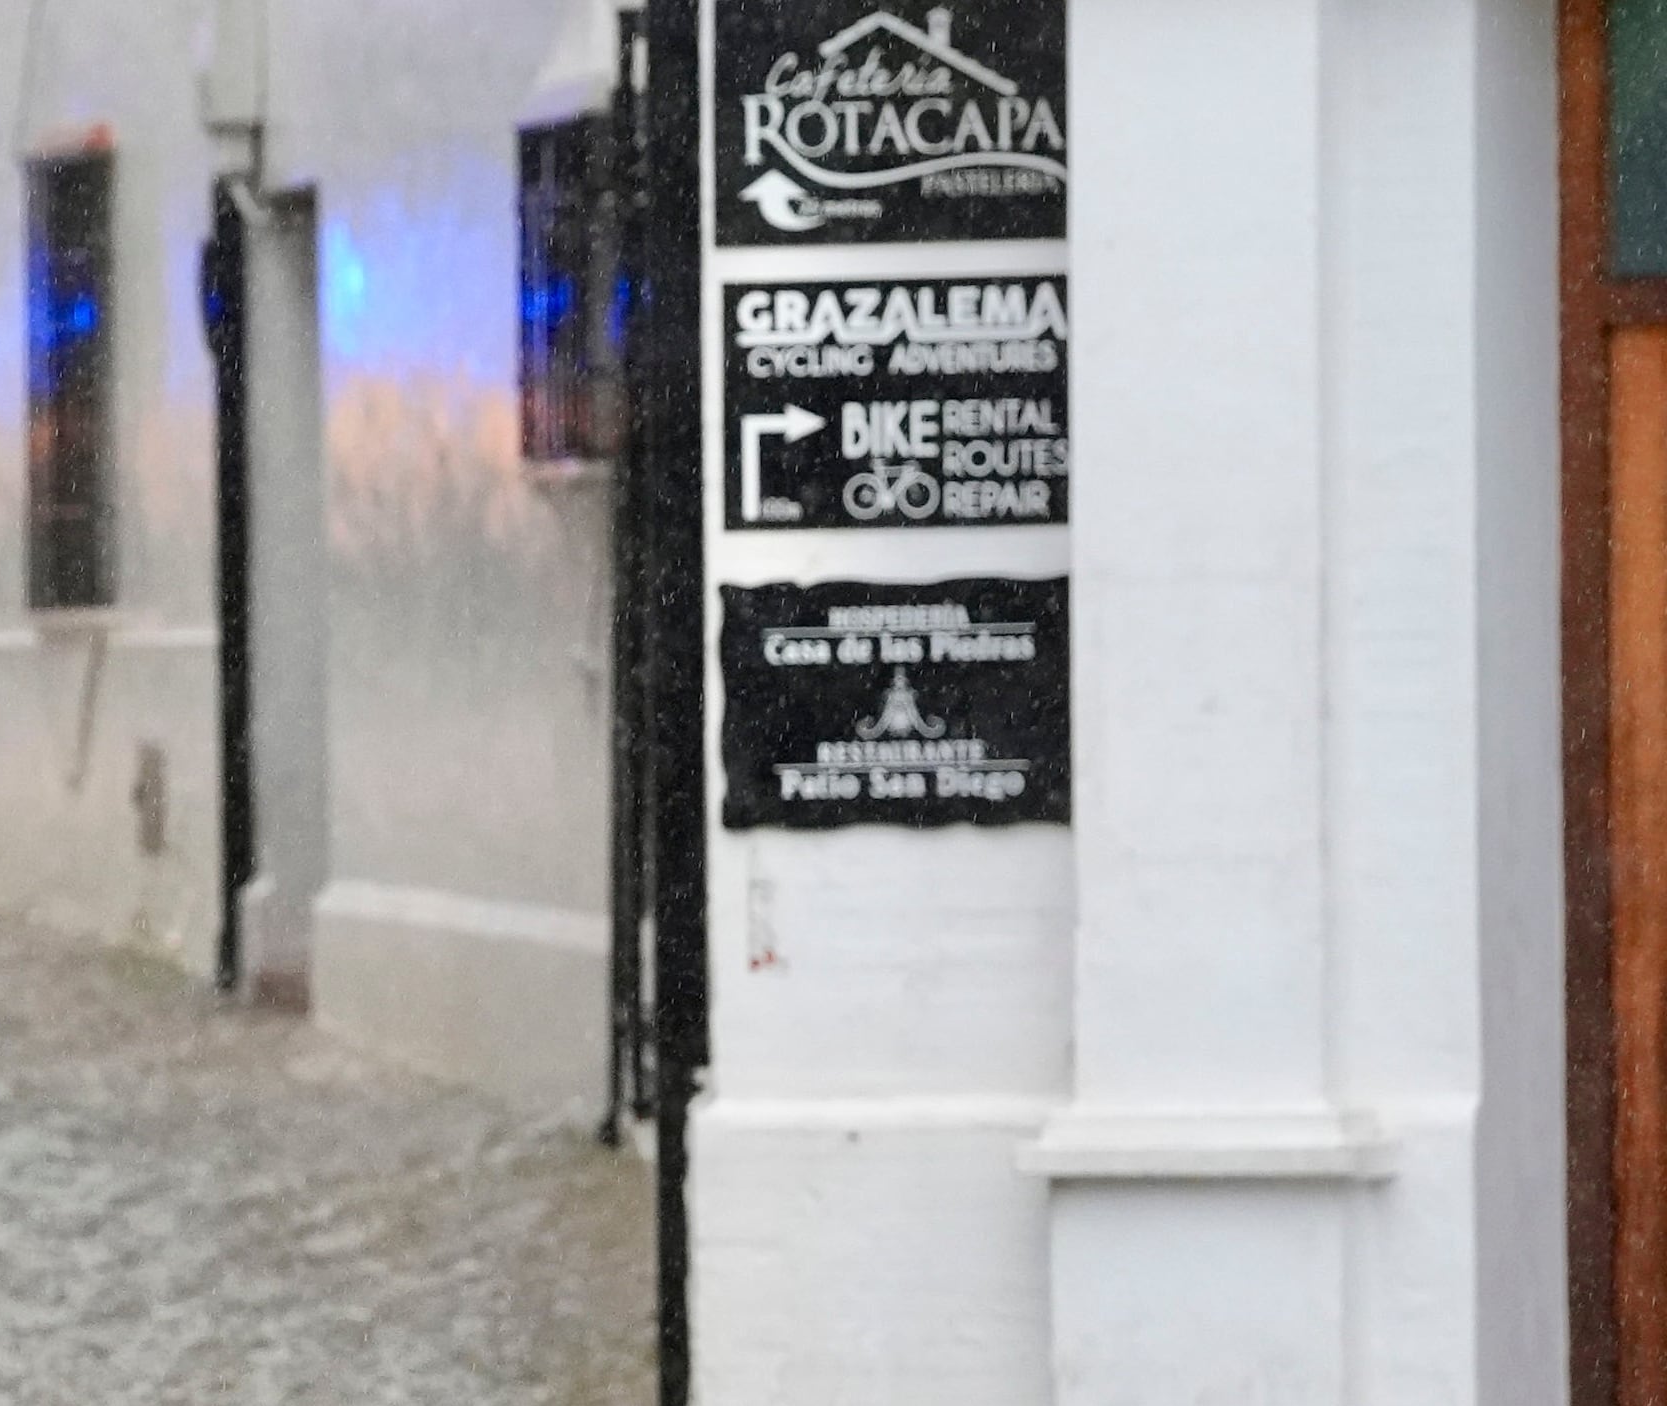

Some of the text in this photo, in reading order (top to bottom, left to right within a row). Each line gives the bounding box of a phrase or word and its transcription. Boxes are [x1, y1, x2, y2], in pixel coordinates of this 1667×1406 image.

[741, 94, 1065, 166] ROTACAPA
[735, 281, 1067, 340] GRAZALEMA
[747, 339, 1059, 379] CYCLING ADVENTURES
[841, 401, 941, 459] BIKE
[942, 400, 1059, 436] RENTAL
[942, 439, 1067, 478] ROUTES
[942, 480, 1052, 518] REPAIR
[780, 769, 862, 800] Patio
[936, 766, 1026, 800] Diego
